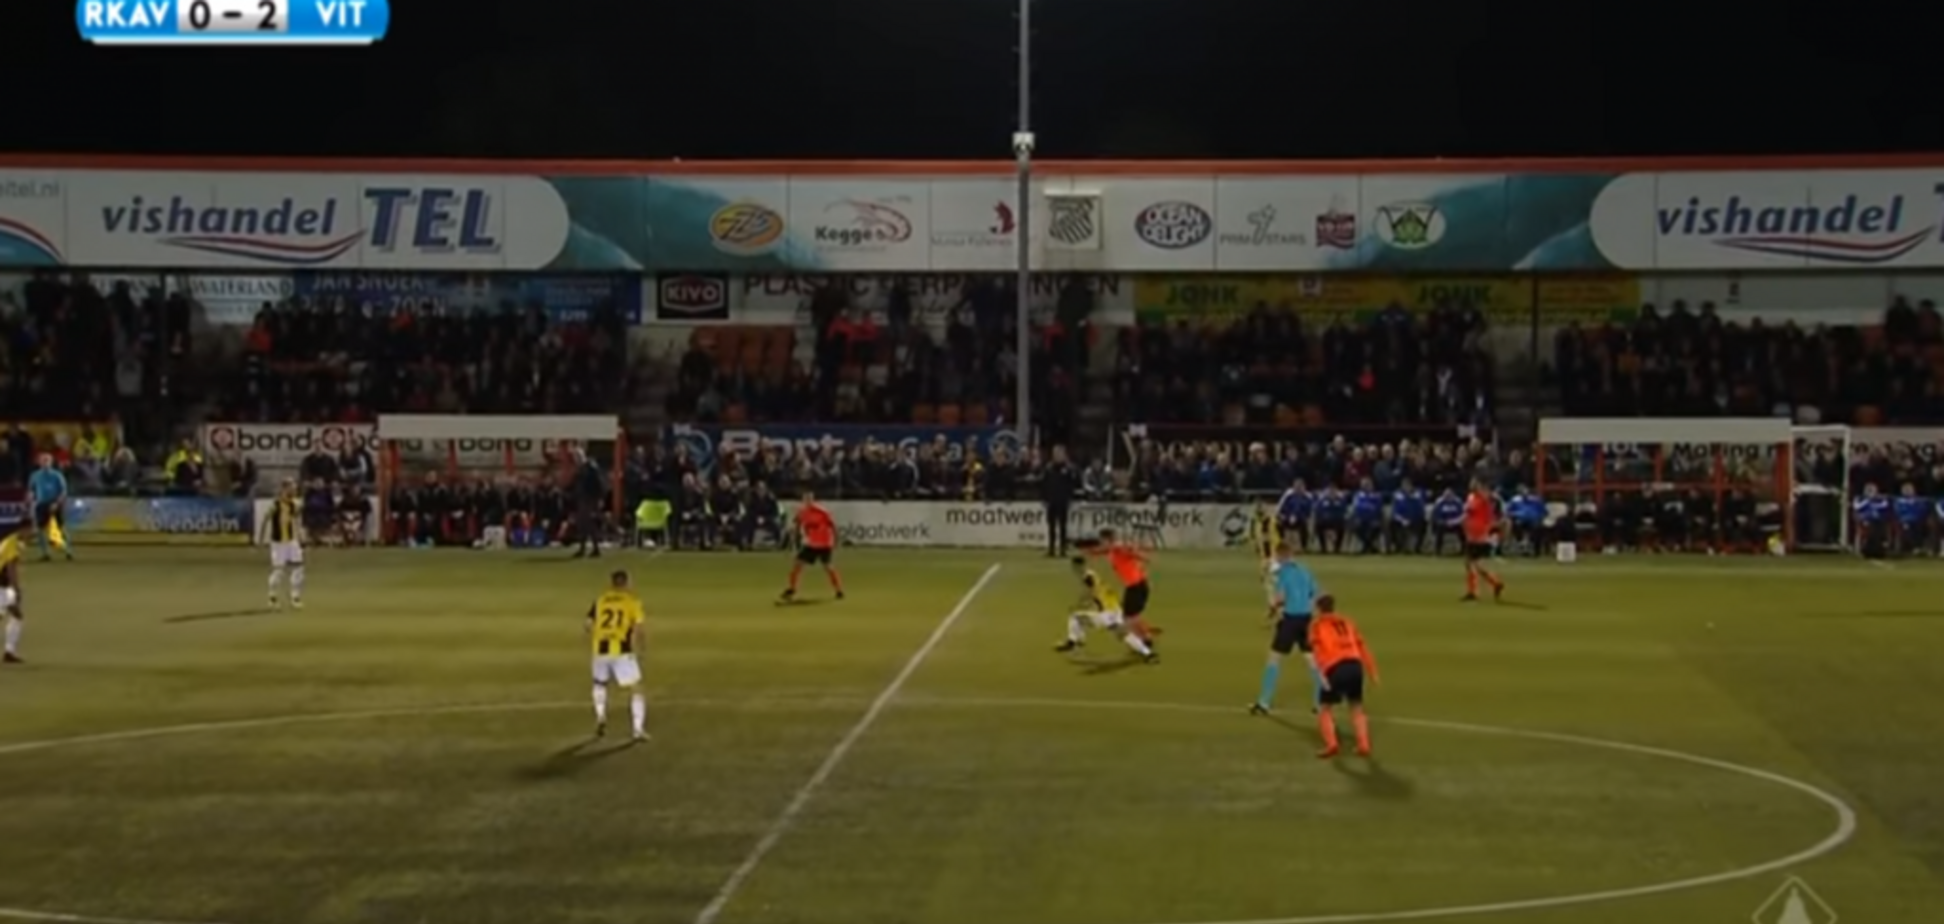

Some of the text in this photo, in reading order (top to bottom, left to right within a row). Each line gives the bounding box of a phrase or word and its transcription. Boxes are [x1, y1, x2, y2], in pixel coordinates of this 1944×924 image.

[103, 187, 500, 254] vishandel TEL
[1658, 195, 1903, 235] vishandel
[666, 285, 718, 301] KIVO
[744, 273, 870, 297] PLASIC
[945, 508, 1045, 526] maatwer
[601, 608, 625, 630] 21
